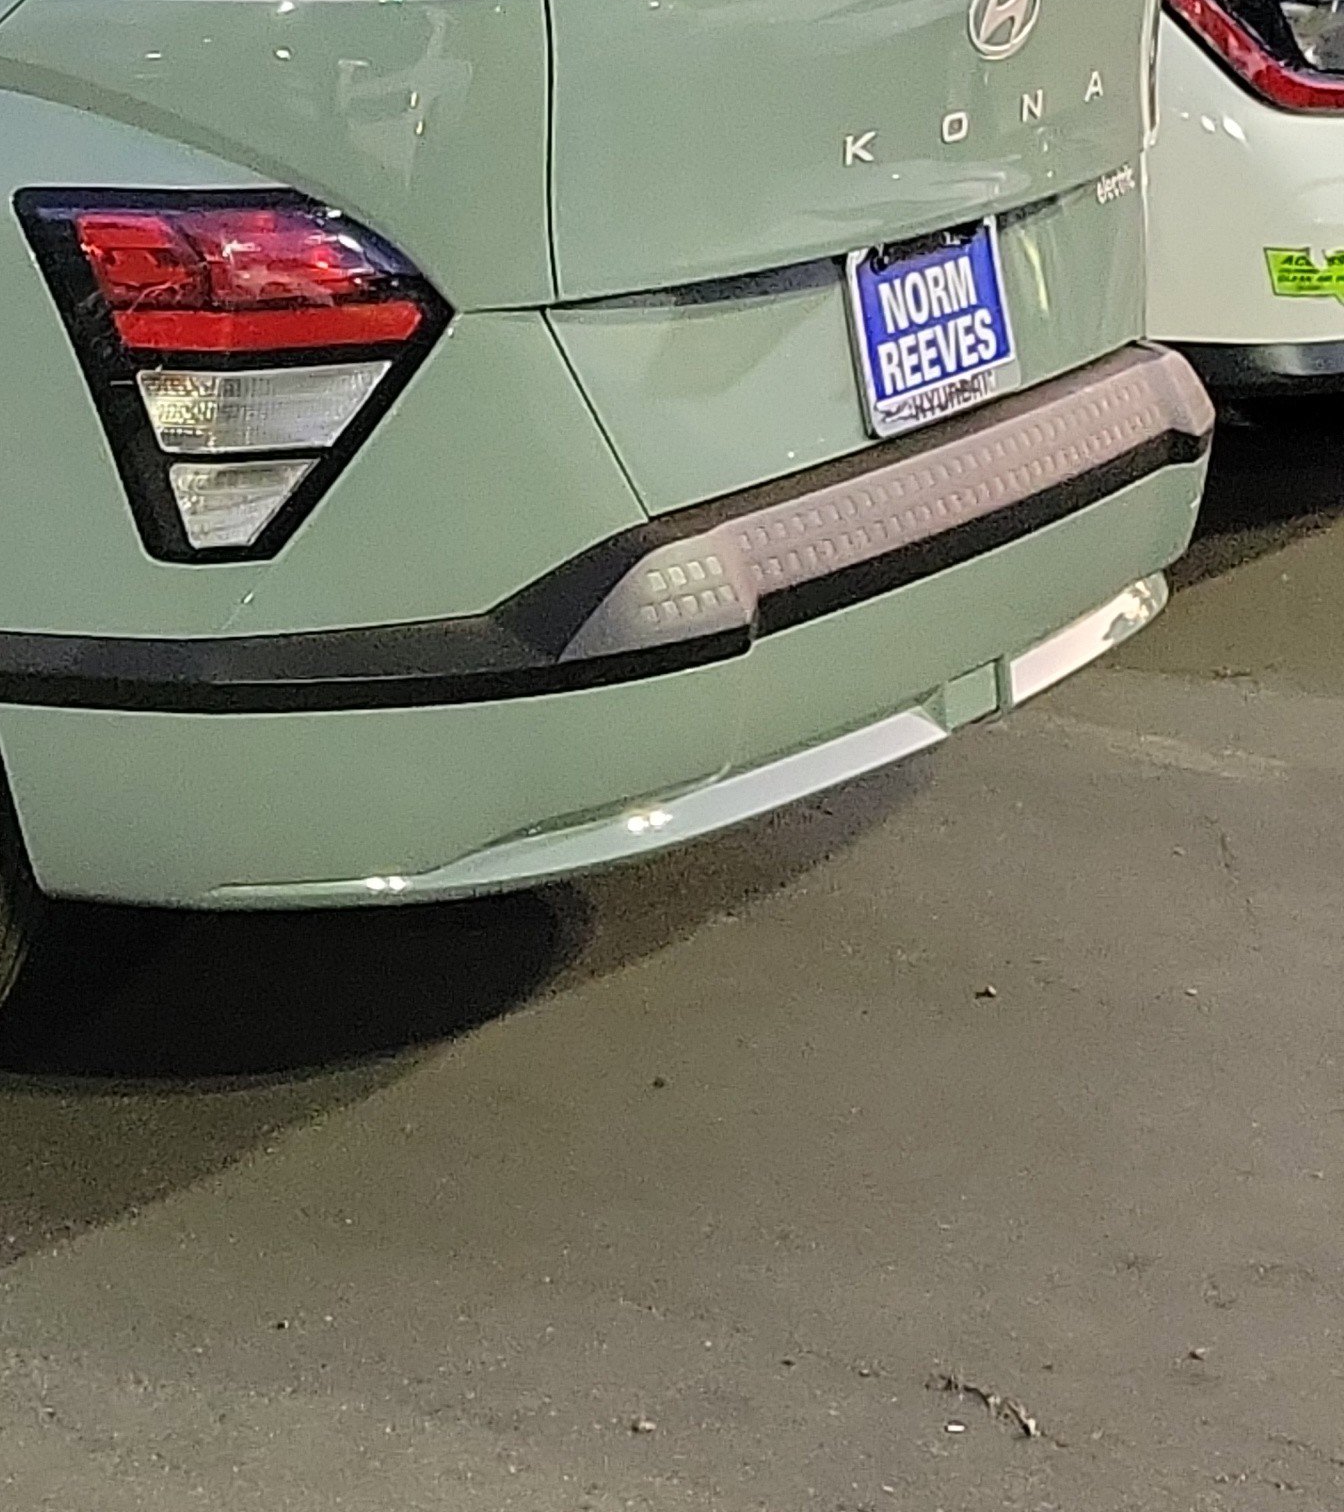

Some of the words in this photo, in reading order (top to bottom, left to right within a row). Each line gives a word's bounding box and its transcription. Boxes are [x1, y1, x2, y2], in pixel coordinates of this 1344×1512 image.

[843, 70, 1105, 166] KONA
[877, 255, 978, 334] NORM
[876, 308, 998, 396] REEVES
